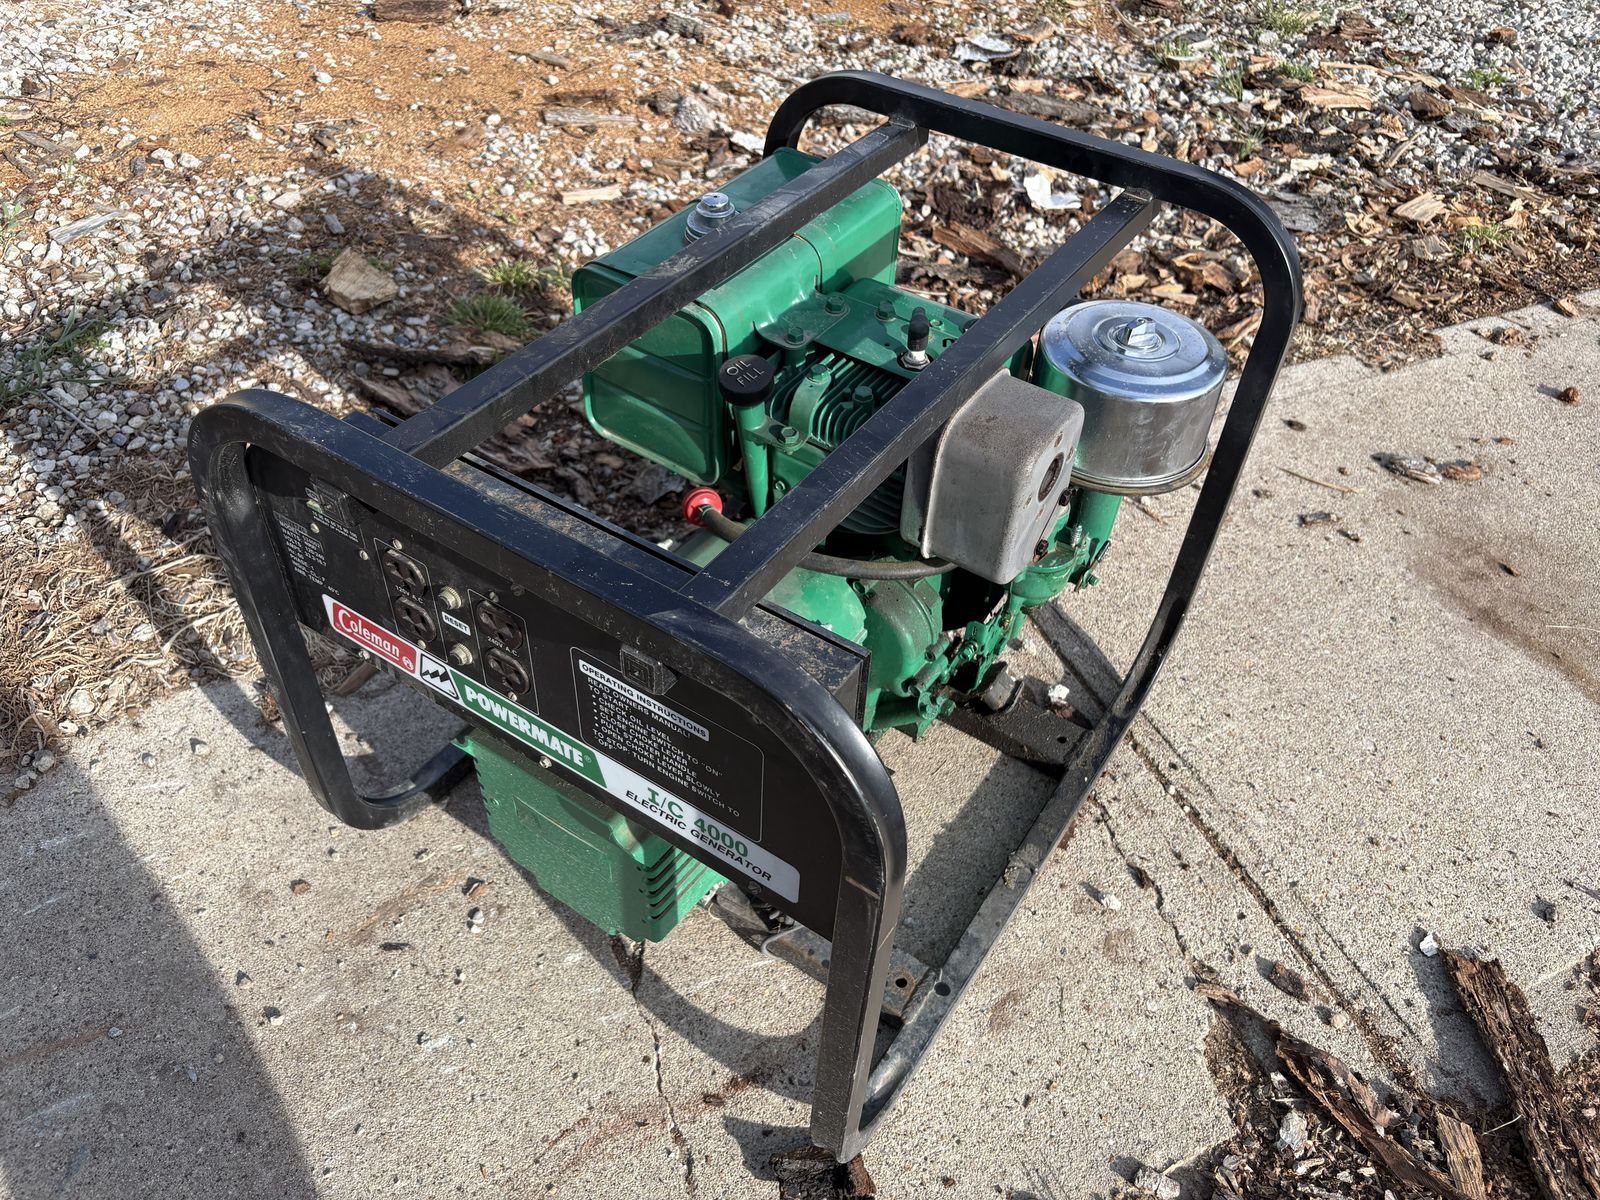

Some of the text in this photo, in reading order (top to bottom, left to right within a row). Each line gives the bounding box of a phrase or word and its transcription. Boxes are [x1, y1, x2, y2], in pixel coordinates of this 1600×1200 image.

[726, 360, 752, 376] OIL
[736, 367, 765, 386] FILL
[338, 609, 400, 657] Coleman
[444, 612, 470, 634] RESET
[487, 636, 504, 649] 240V
[582, 662, 706, 738] OPERATING INSTRUCTIONS
[587, 676, 609, 694] READ
[612, 690, 648, 715] OWNERS
[588, 684, 631, 713] TO START:
[598, 696, 671, 743] CHECK OIL LEVEL
[464, 684, 585, 768] POWERMATE
[599, 703, 614, 717] SET
[617, 714, 648, 736] ENGINE
[650, 733, 683, 757] SWITCH
[686, 753, 697, 765] TO
[599, 711, 687, 766] CLOSE CHOKE LEVER
[600, 718, 696, 778] PULL STARTER HANDLE
[592, 728, 603, 739] TO
[632, 751, 654, 768] TURN
[657, 765, 688, 788] ENGINE
[691, 785, 724, 809] SWITCH
[727, 806, 739, 817] TO
[601, 725, 720, 799] OPEN CHOKE LEVER SLOWLY
[626, 789, 771, 881] ELECTRIC GENERATOR
[648, 787, 748, 857] I/C 4000
